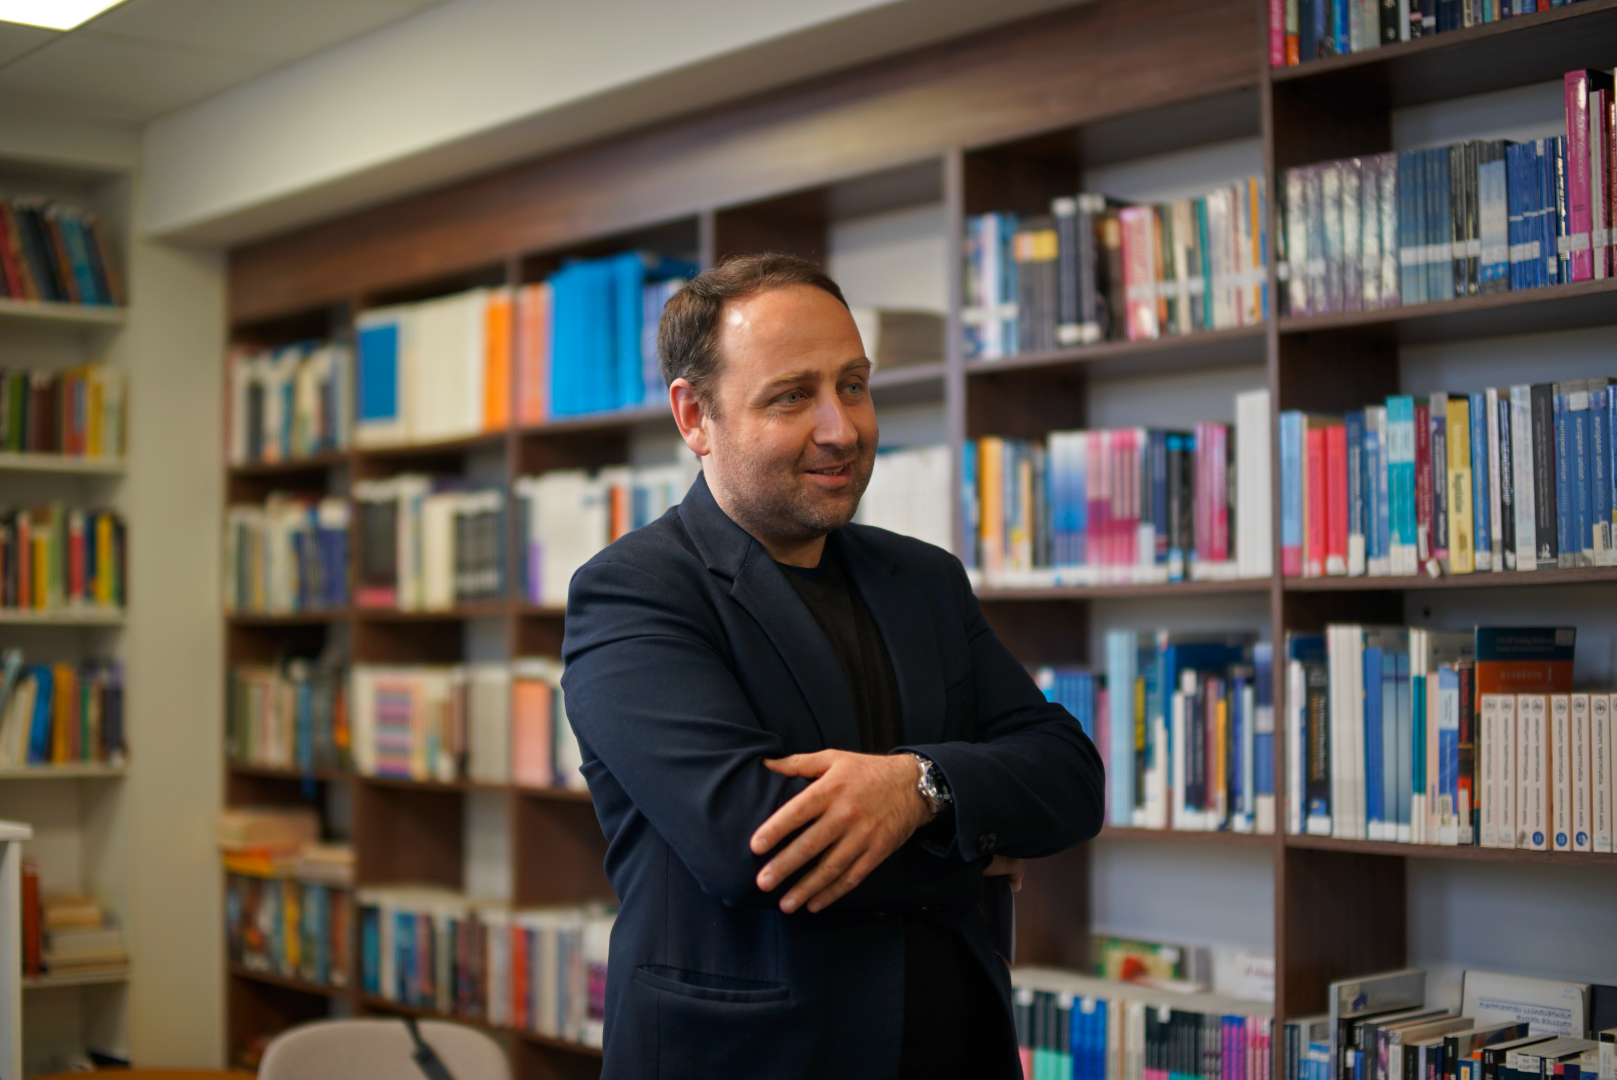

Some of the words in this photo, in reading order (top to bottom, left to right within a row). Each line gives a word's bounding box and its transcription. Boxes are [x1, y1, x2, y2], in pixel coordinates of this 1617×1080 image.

[1576, 417, 1584, 455] european
[1594, 416, 1602, 454] european
[1502, 443, 1511, 506] LEADERSHIP
[1596, 456, 1604, 479] union
[1454, 473, 1464, 514] Negotiation
[1578, 481, 1586, 511] politics
[1597, 481, 1605, 510] politics
